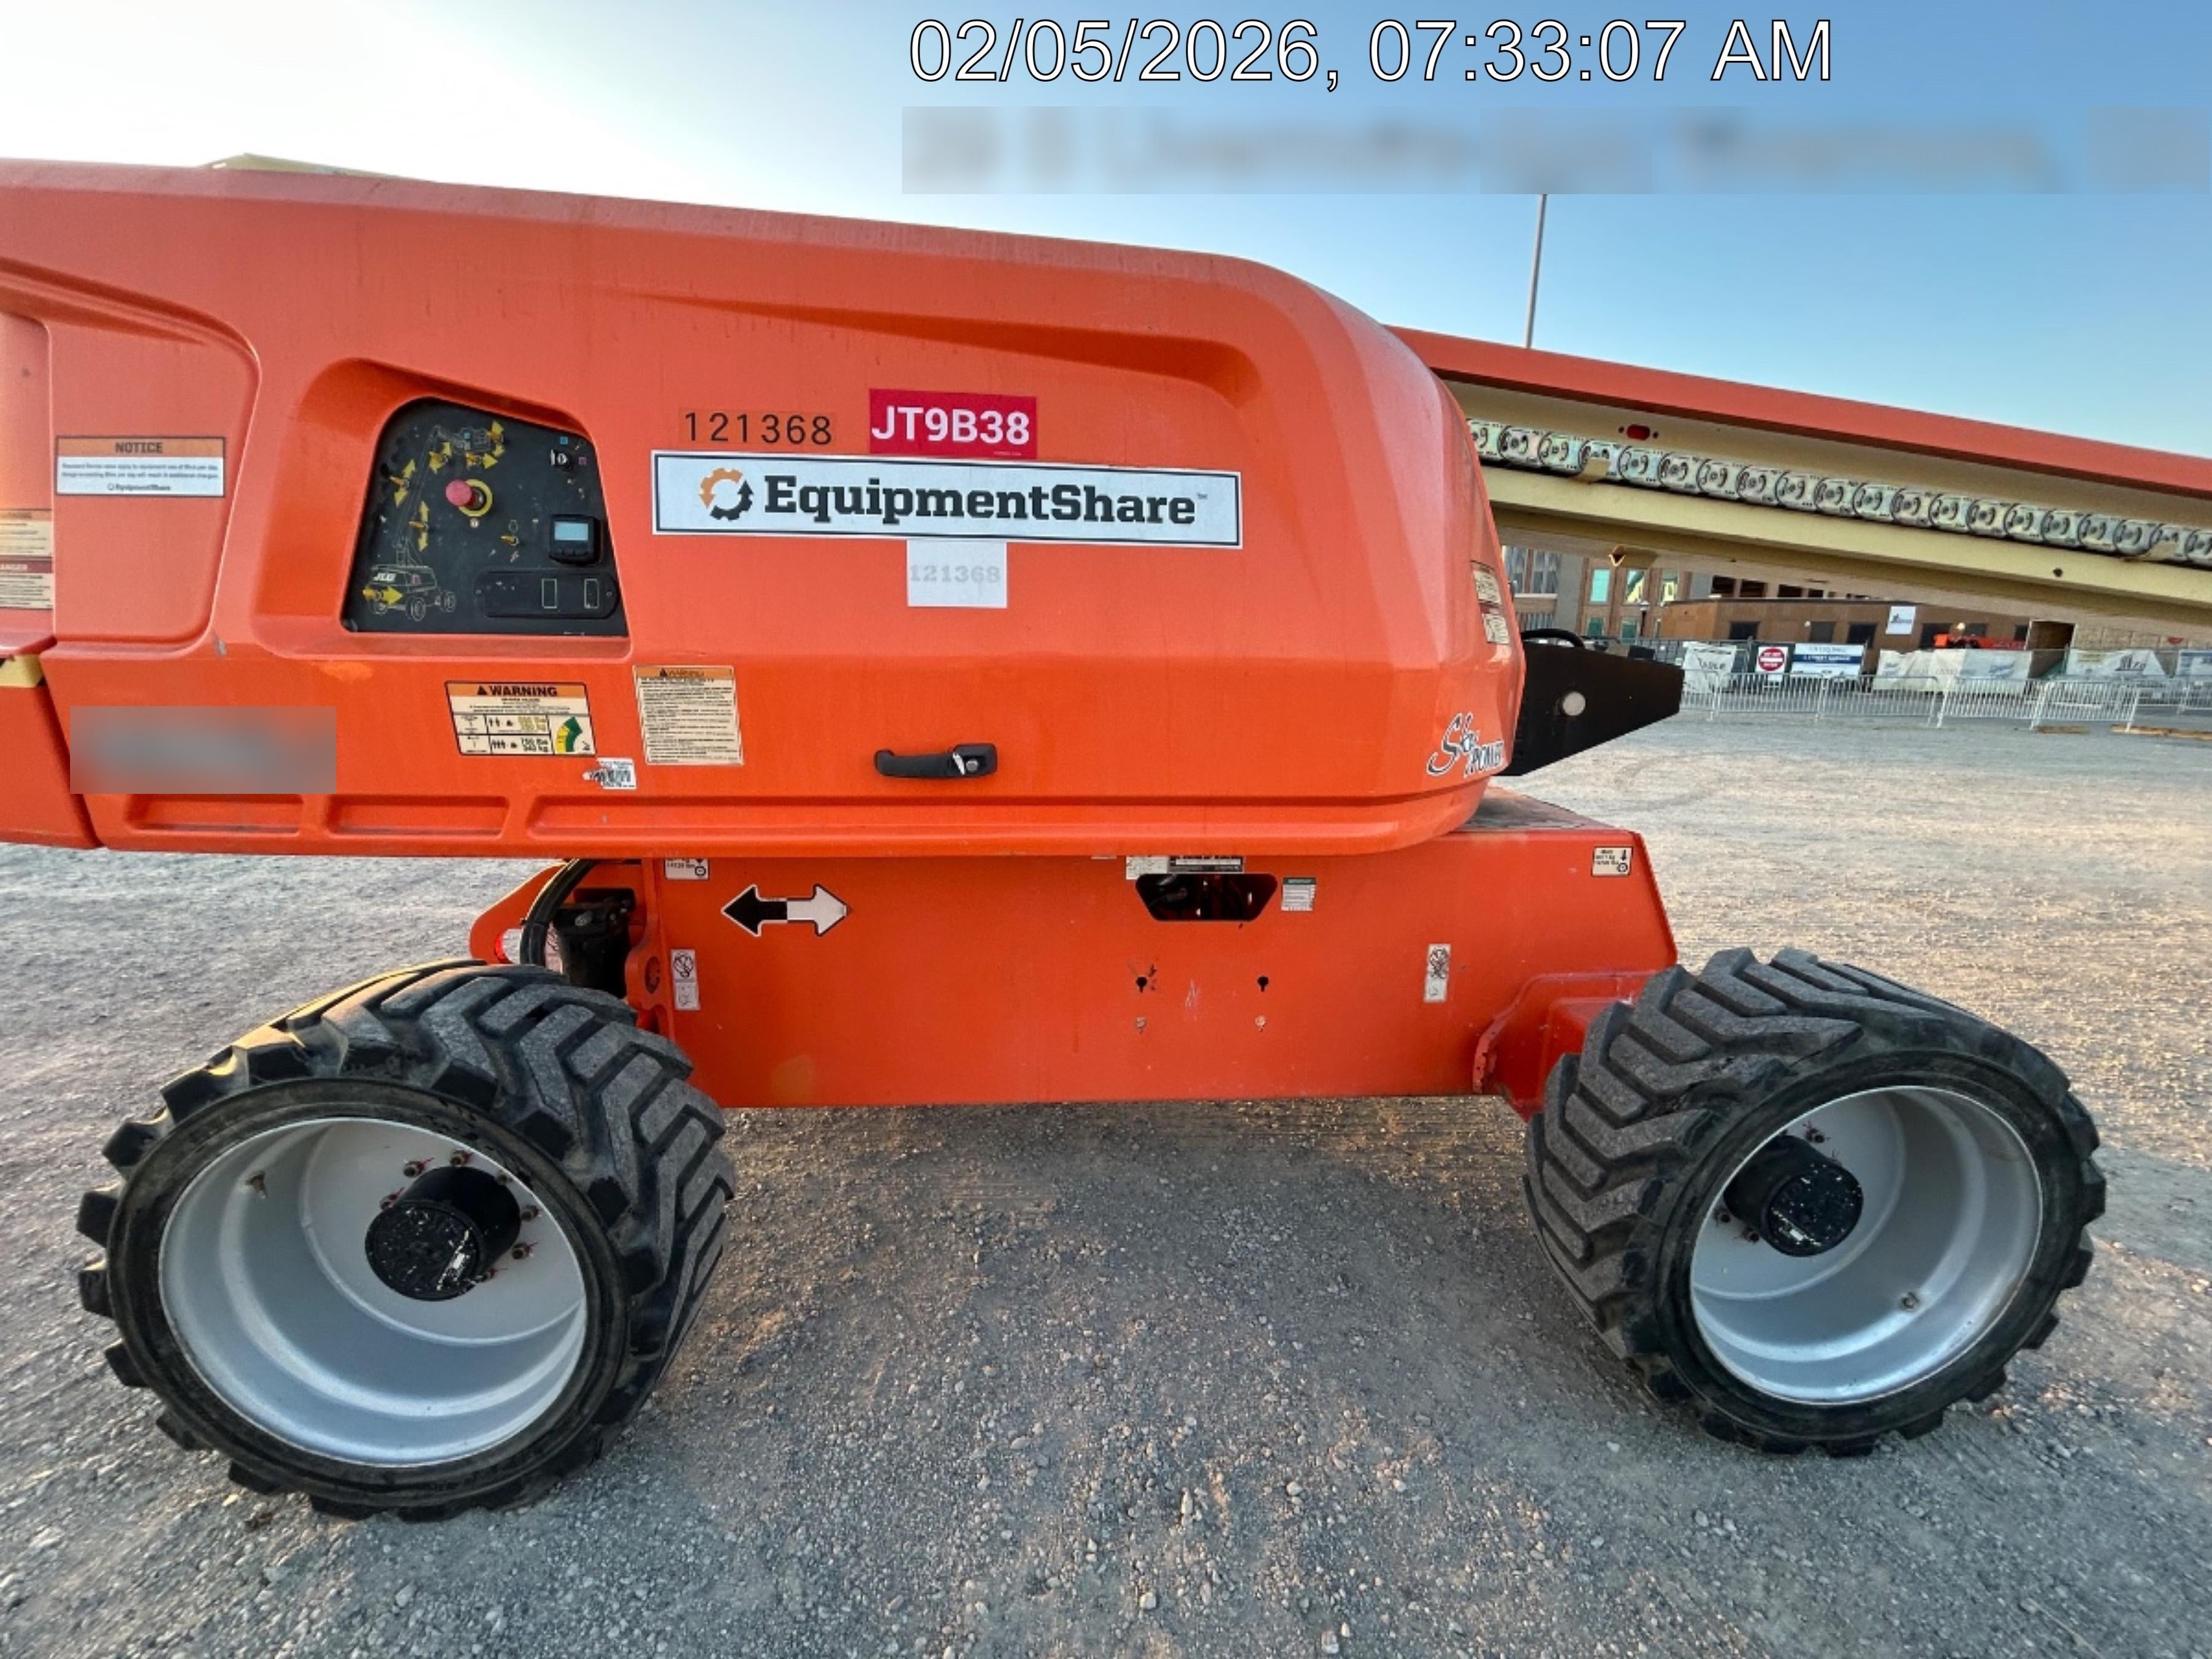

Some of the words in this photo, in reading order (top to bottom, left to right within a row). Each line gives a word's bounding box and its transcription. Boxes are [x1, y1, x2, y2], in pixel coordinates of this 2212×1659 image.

[685, 412, 832, 445] 121368
[871, 406, 1030, 445] JT9B38
[115, 441, 163, 453] NOTICE
[765, 475, 1196, 525] EquipmentShare
[909, 564, 1001, 583] 121368
[490, 685, 557, 697] WARNING
